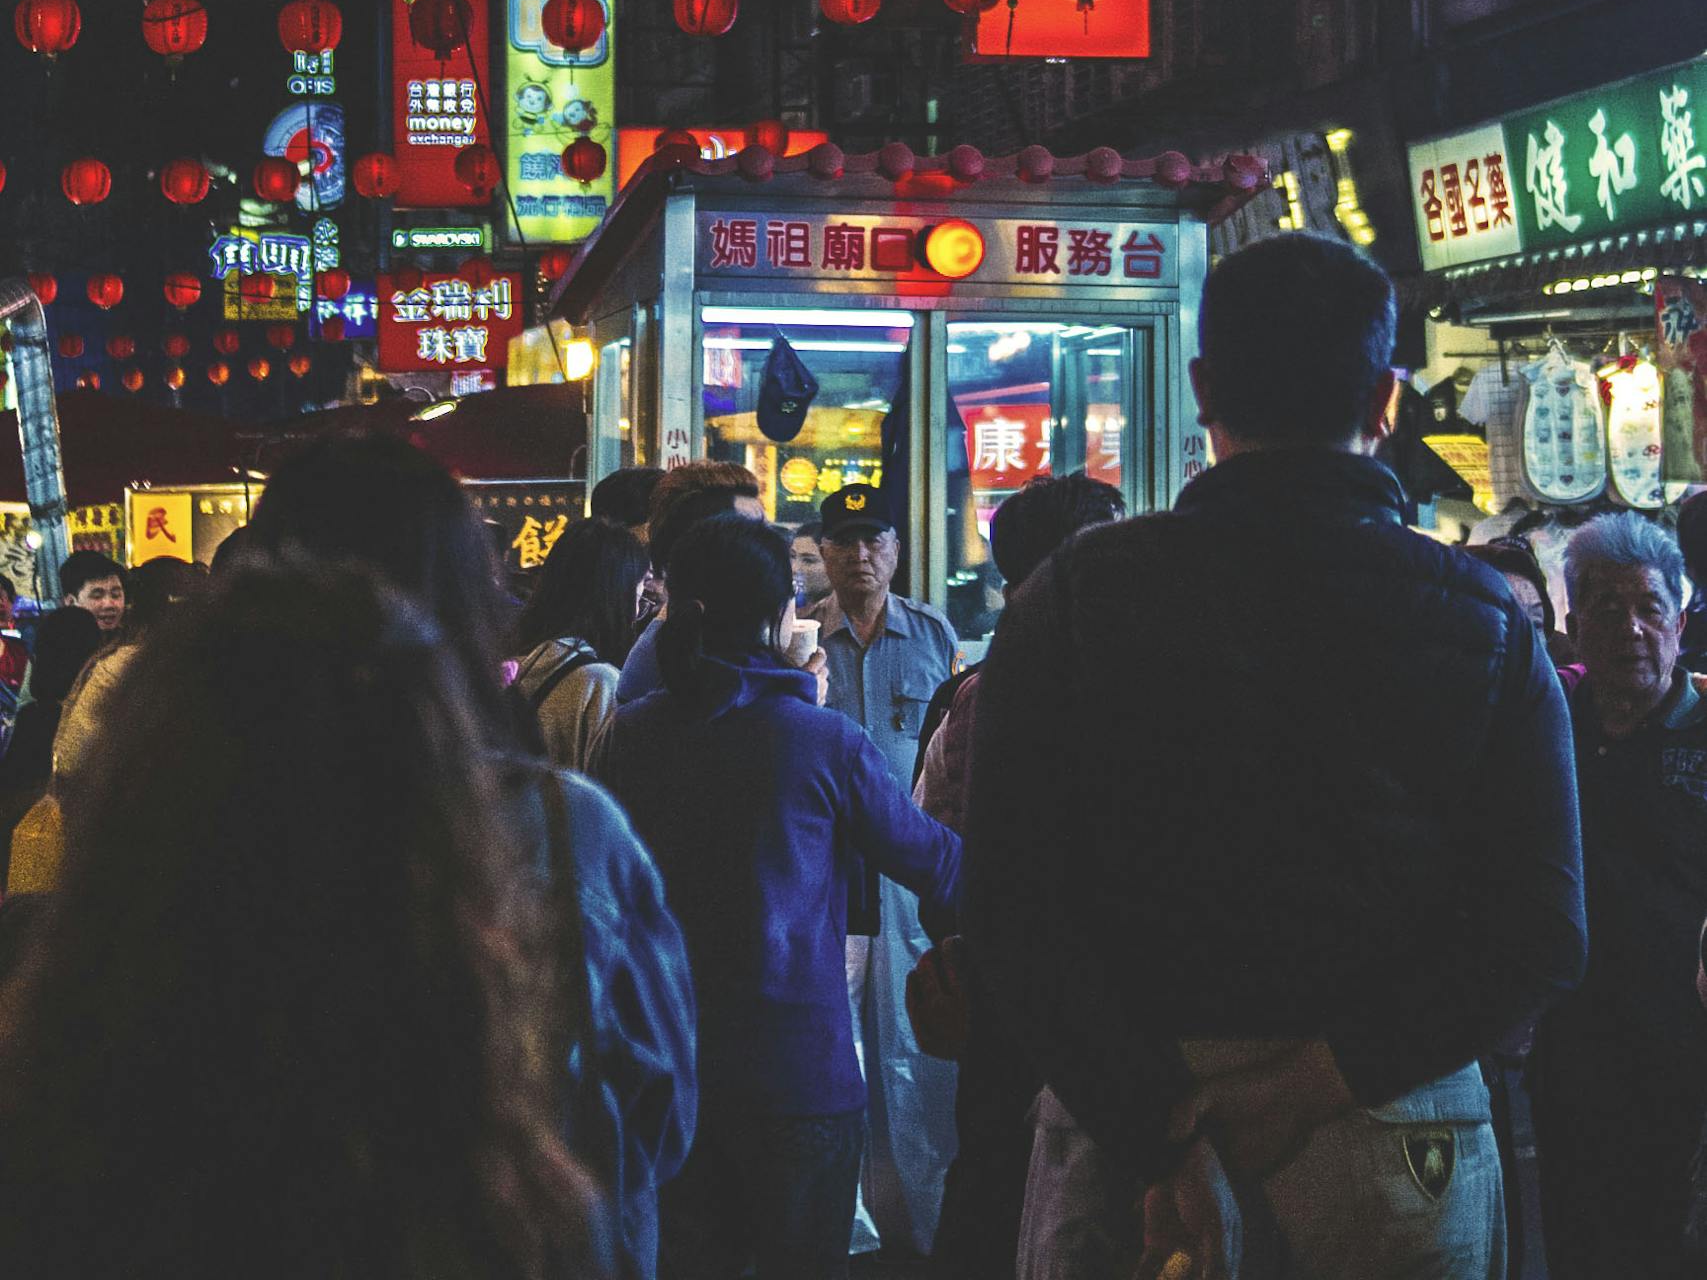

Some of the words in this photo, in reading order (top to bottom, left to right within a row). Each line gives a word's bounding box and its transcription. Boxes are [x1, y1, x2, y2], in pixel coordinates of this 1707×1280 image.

[409, 116, 474, 134] money
[1420, 151, 1512, 242] 各國名藥
[710, 219, 914, 271] 媽祖廟口
[1016, 226, 1165, 278] 服務台
[391, 278, 512, 323] 金瑞利
[417, 326, 488, 363] 珠寶
[145, 507, 176, 544] 民
